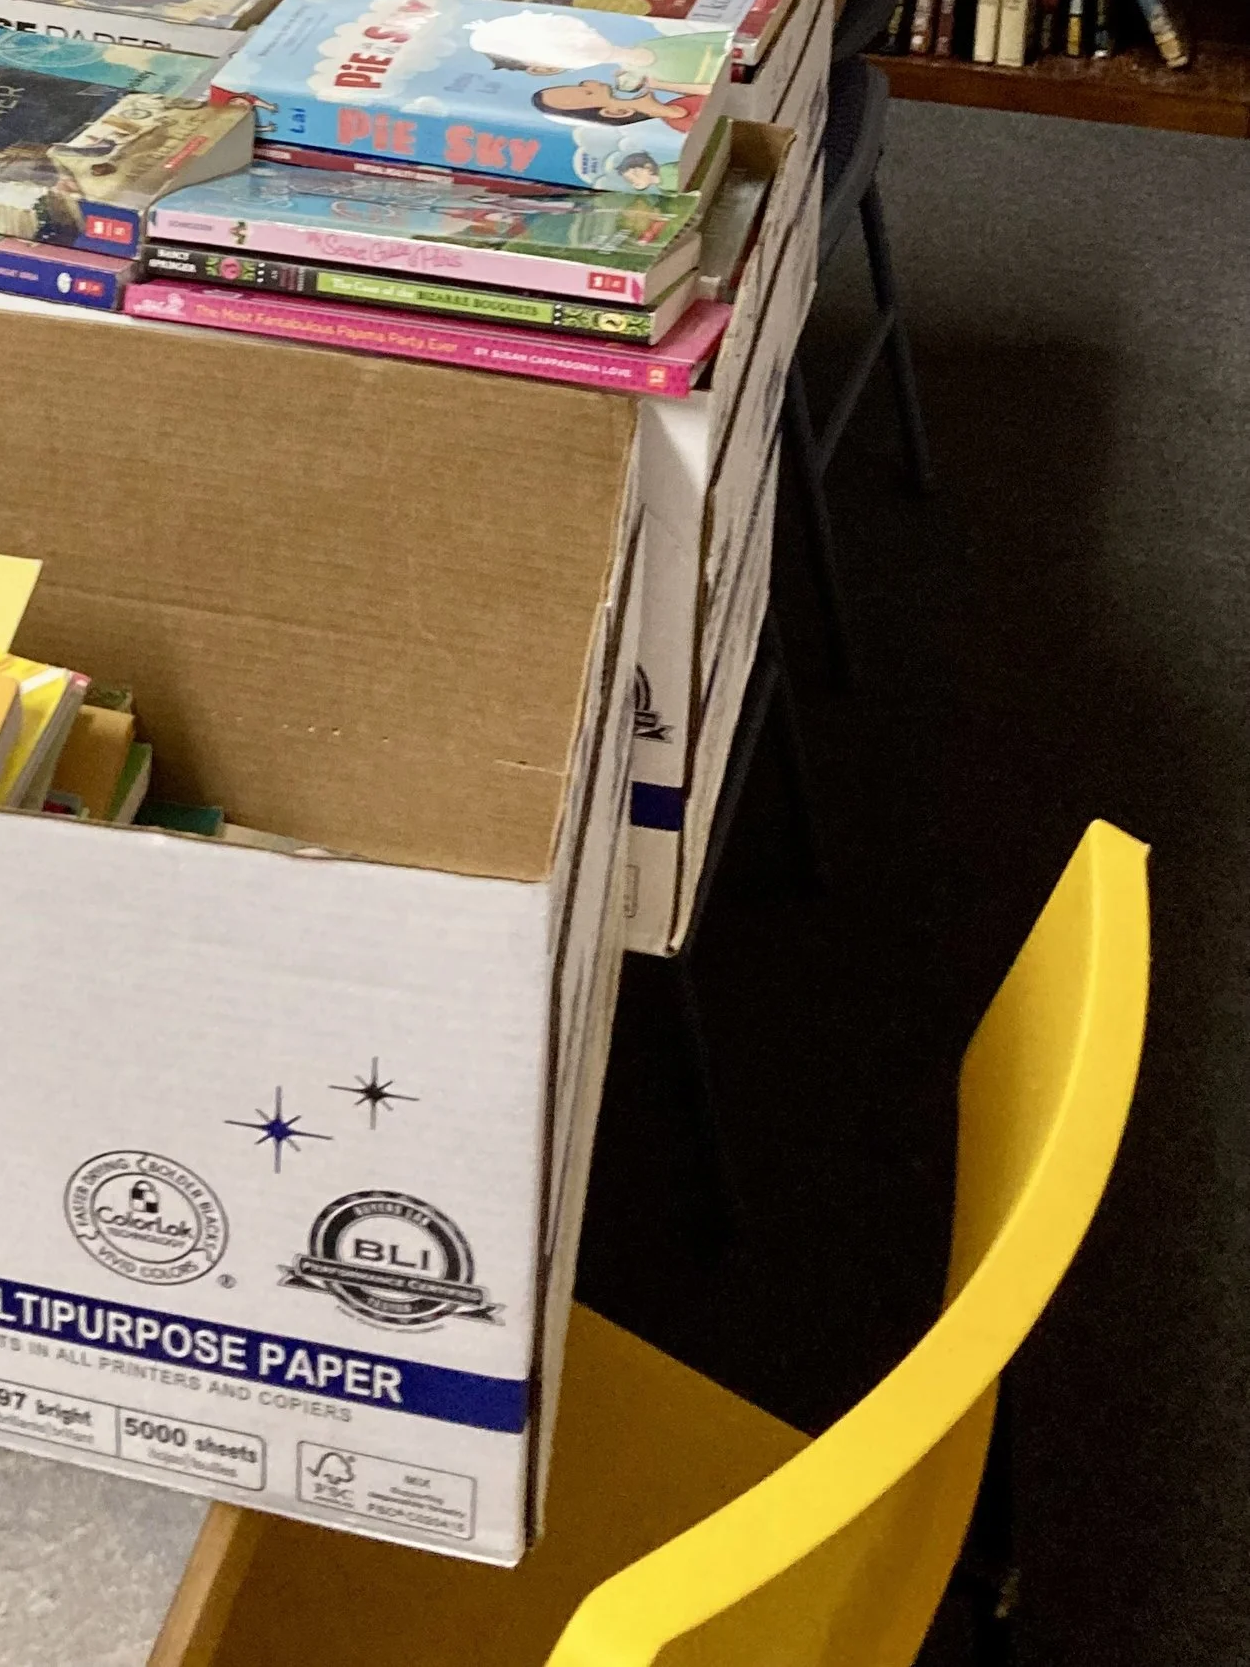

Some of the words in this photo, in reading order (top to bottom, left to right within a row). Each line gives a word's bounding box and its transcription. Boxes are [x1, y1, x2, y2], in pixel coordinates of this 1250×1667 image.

[444, 125, 541, 173] SKY
[149, 259, 197, 274] SPRINGER
[331, 277, 353, 290] The
[354, 280, 380, 294] Case
[382, 286, 396, 296] of
[397, 287, 416, 300] the
[415, 290, 470, 307] BIZARRE
[472, 297, 538, 318] BOUQUETS
[196, 304, 219, 318] The
[426, 339, 459, 353] Ever
[473, 346, 489, 357] BY
[491, 349, 527, 363] SUSAN
[600, 366, 633, 379] LOVE
[149, 1160, 204, 1200] BOLDER
[96, 1206, 194, 1238] ColorLok
[98, 1245, 138, 1273] VIVID
[138, 1260, 200, 1279] COLORS
[352, 1237, 432, 1272] BLI
[27, 1340, 52, 1359] IN
[54, 1346, 95, 1369] ALL
[97, 1354, 202, 1395] PRINTERS
[207, 1377, 252, 1401] AND
[256, 1390, 353, 1424] COPIERS
[258, 1341, 405, 1404] PAPER
[35, 1395, 94, 1427] bright
[123, 1416, 188, 1448] 5000
[193, 1433, 258, 1465] sheets
